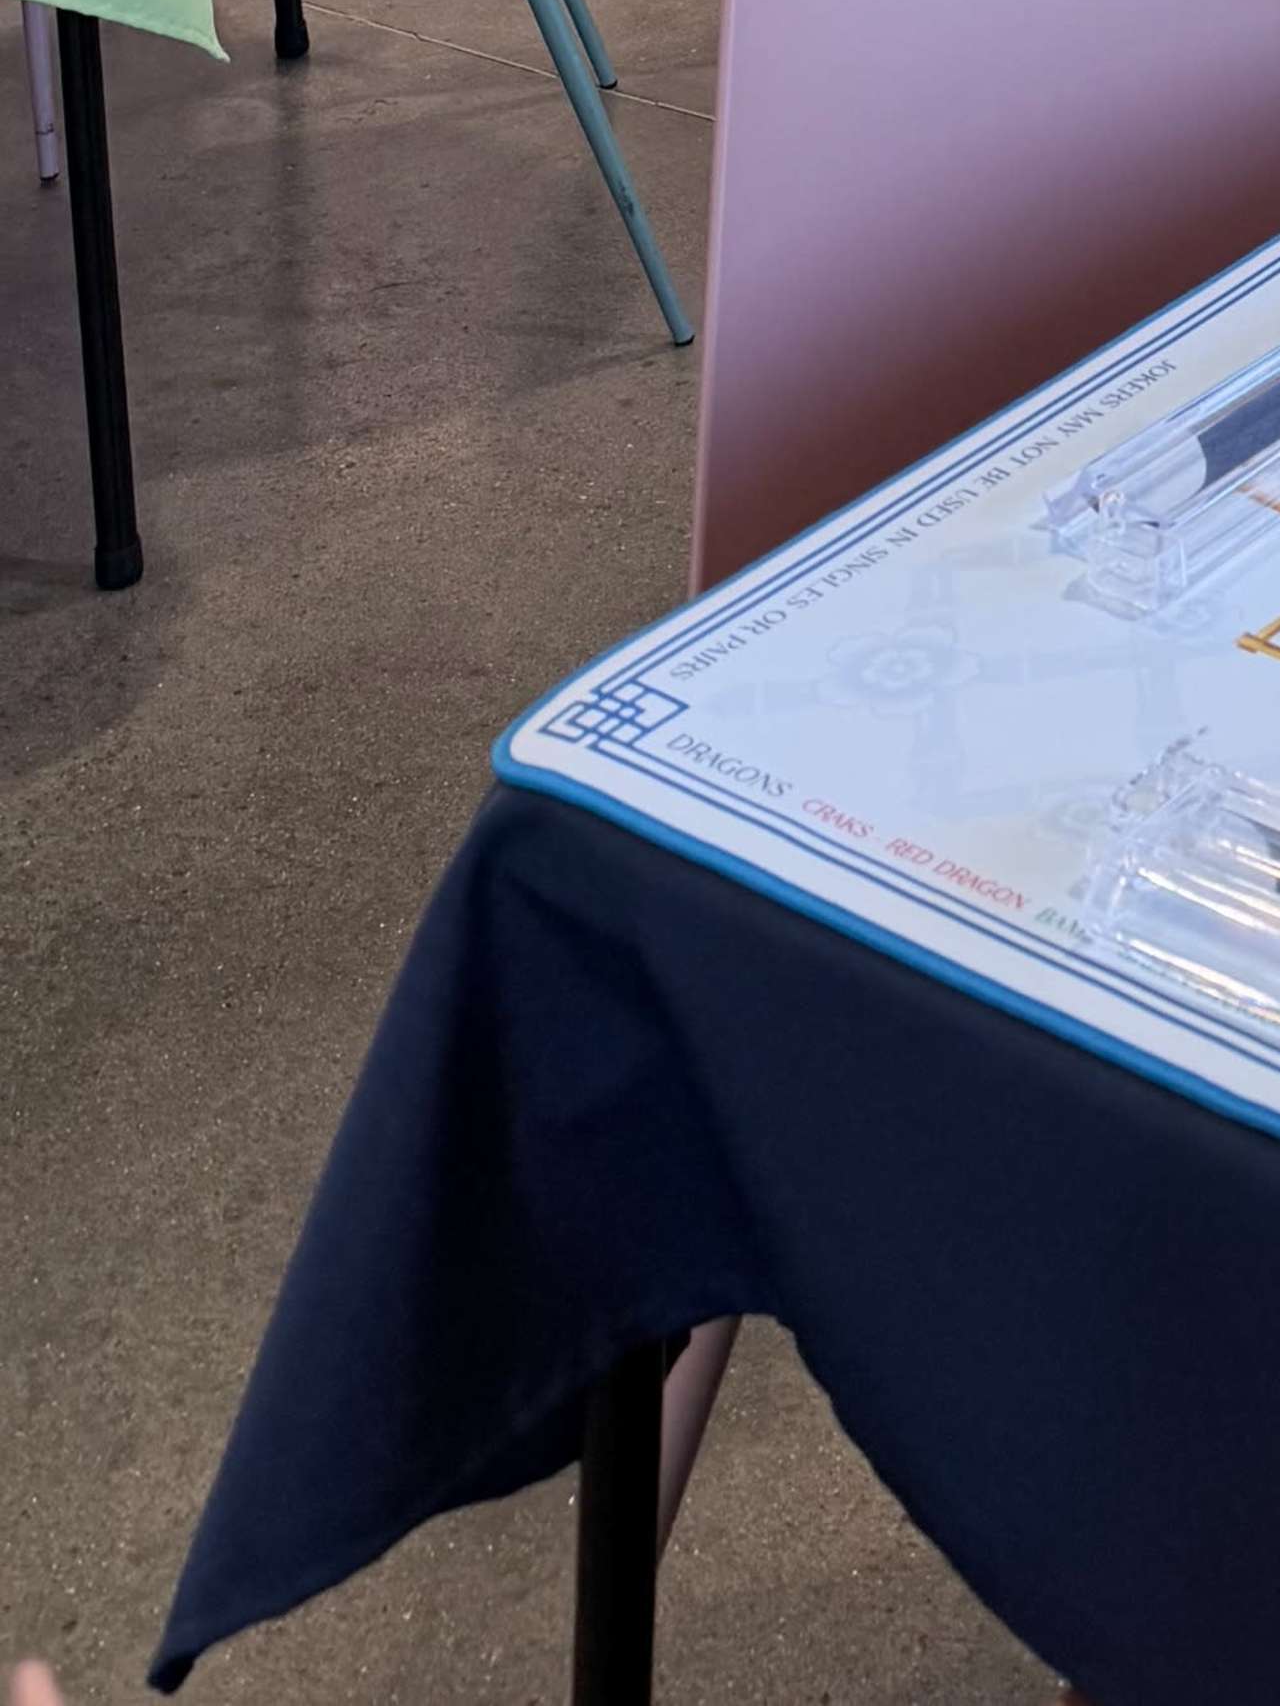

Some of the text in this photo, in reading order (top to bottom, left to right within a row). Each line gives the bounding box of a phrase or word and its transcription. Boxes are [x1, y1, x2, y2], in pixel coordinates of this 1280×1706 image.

[668, 358, 1177, 683] JOKERS MAY NOT BE USED IN SINGLES OR PAIRS
[666, 732, 793, 798] DRAGONS
[801, 797, 875, 840] CRAKS
[885, 836, 934, 868] RED
[932, 857, 1032, 914] DRAGON
